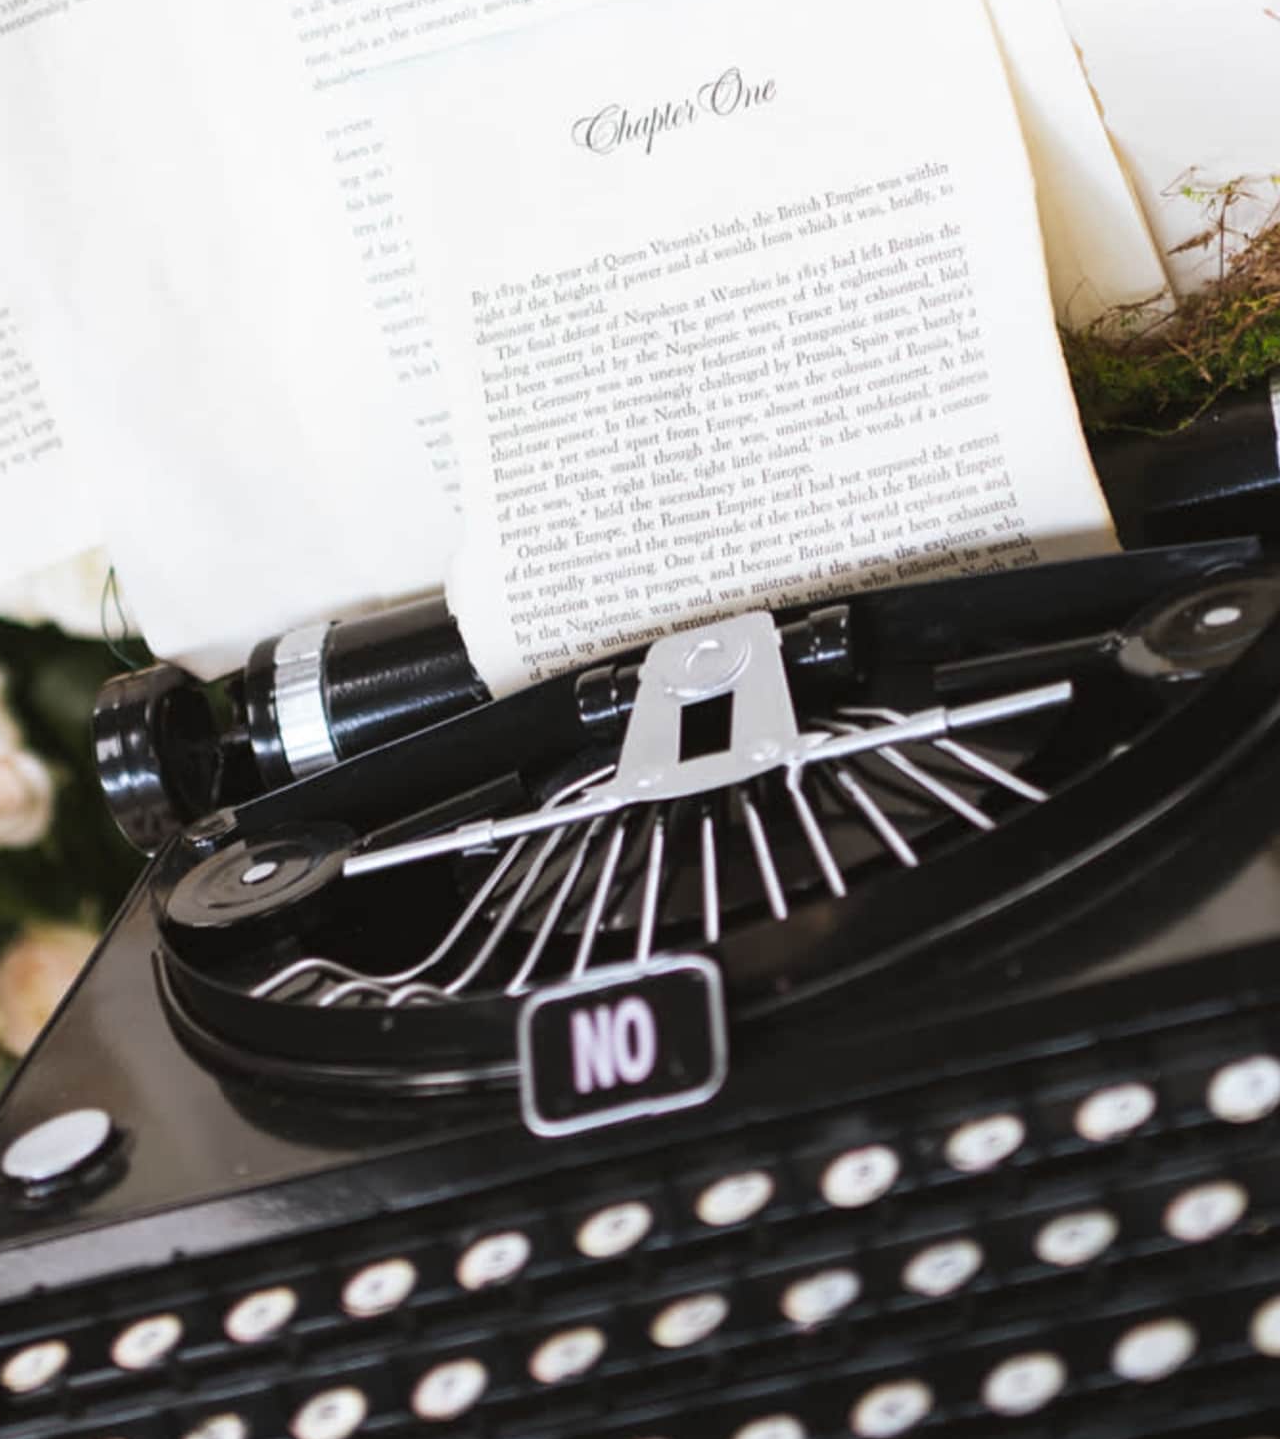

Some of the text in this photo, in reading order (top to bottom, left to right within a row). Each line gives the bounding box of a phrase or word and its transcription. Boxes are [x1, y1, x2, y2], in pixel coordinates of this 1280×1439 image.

[572, 67, 777, 156] Chapter One
[530, 273, 554, 291] the
[554, 267, 583, 287] year
[583, 257, 601, 276] of
[601, 249, 648, 273] Queen
[751, 210, 776, 229] the
[776, 196, 822, 222] British
[823, 184, 874, 209] Empire
[875, 175, 903, 194] was
[903, 162, 950, 185] within
[509, 597, 590, 626] exploitation
[593, 592, 621, 608] was
[623, 585, 640, 601] in
[709, 561, 736, 582] and
[740, 551, 796, 575] because
[797, 539, 845, 561] Britain
[849, 528, 877, 548] had
[880, 523, 905, 542] not
[907, 516, 942, 535] been
[946, 492, 1019, 525] exhausted
[514, 630, 534, 647] by
[537, 624, 563, 641] the
[565, 606, 643, 635] Napoleonic
[648, 600, 682, 616] wars
[686, 590, 714, 609] and
[718, 587, 746, 602] was
[750, 573, 804, 596] mistress
[808, 564, 824, 581] of
[828, 560, 853, 577] the
[894, 545, 918, 564] the
[923, 528, 988, 553] explorers
[992, 515, 1025, 532] who
[570, 994, 658, 1095] NO
